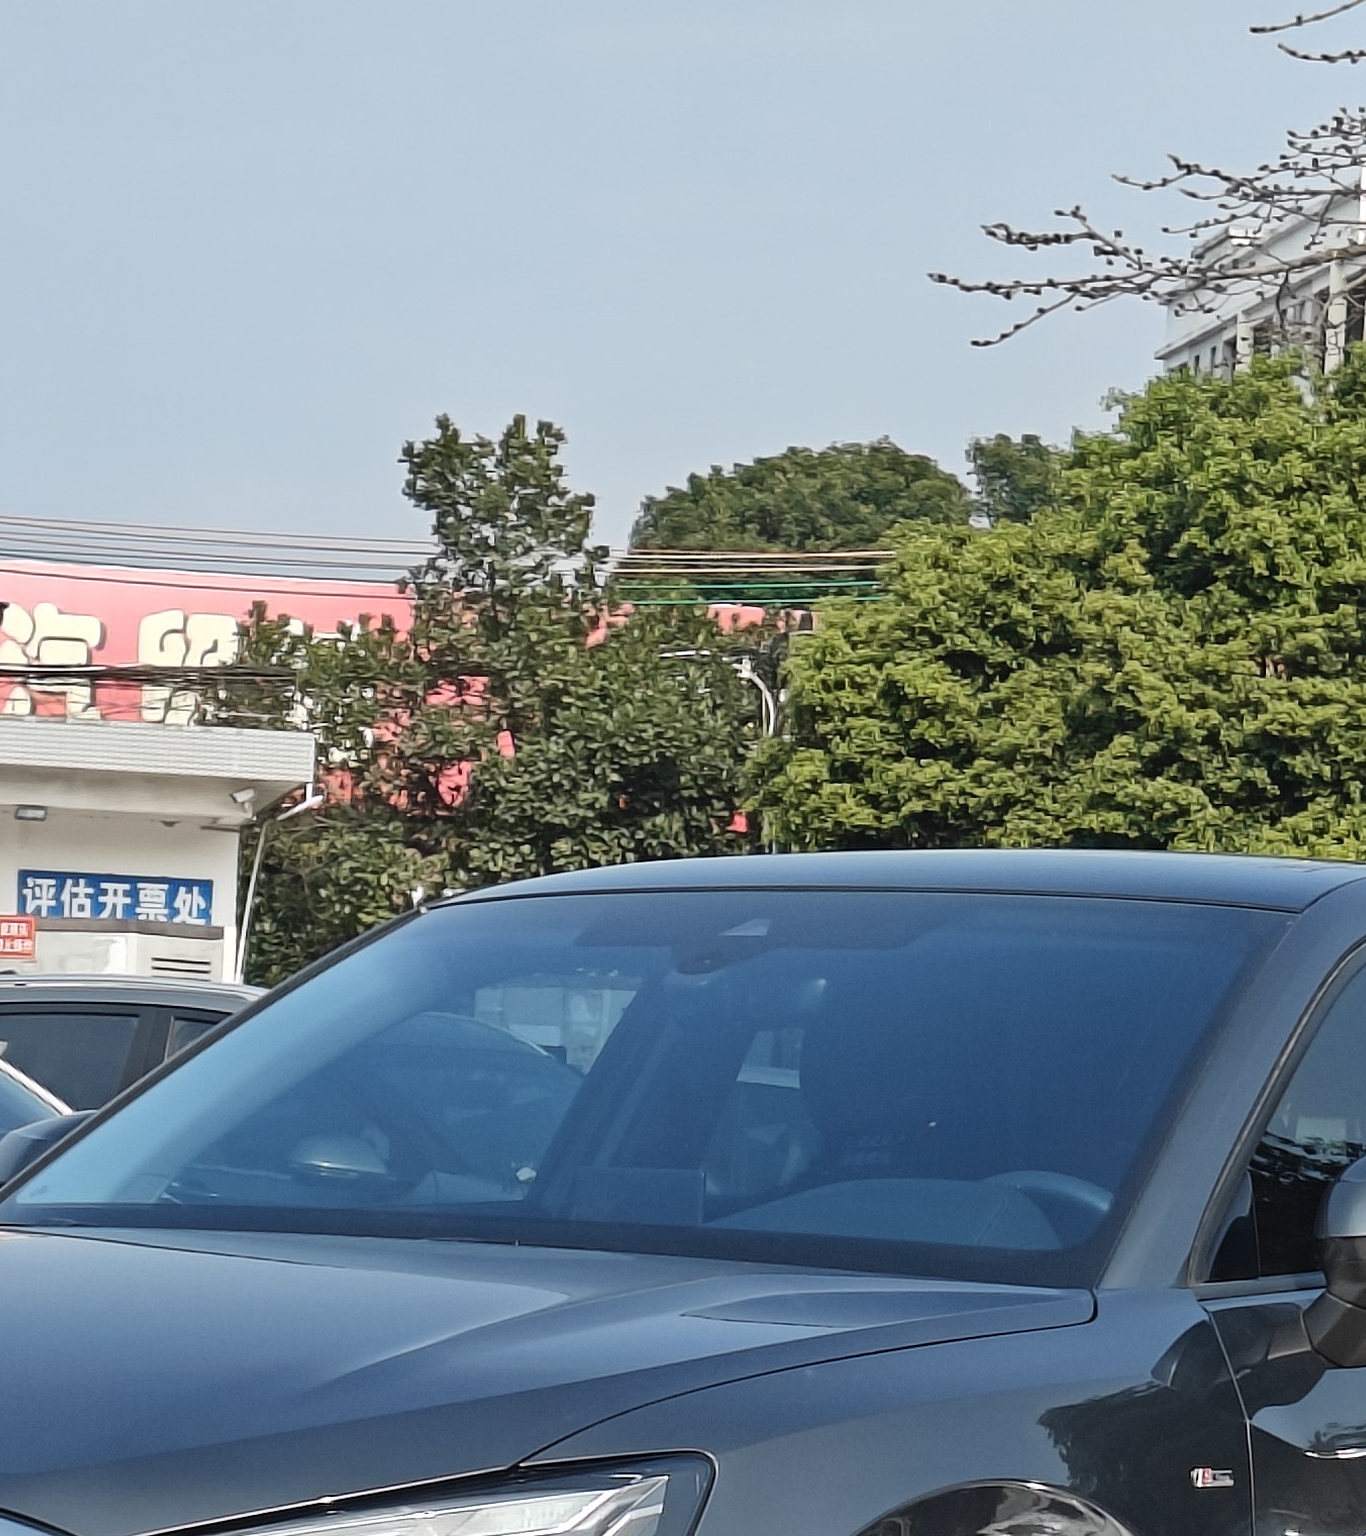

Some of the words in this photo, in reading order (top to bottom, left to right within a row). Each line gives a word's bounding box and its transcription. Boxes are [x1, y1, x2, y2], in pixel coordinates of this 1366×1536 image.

[22, 876, 206, 926] 评估开票处
